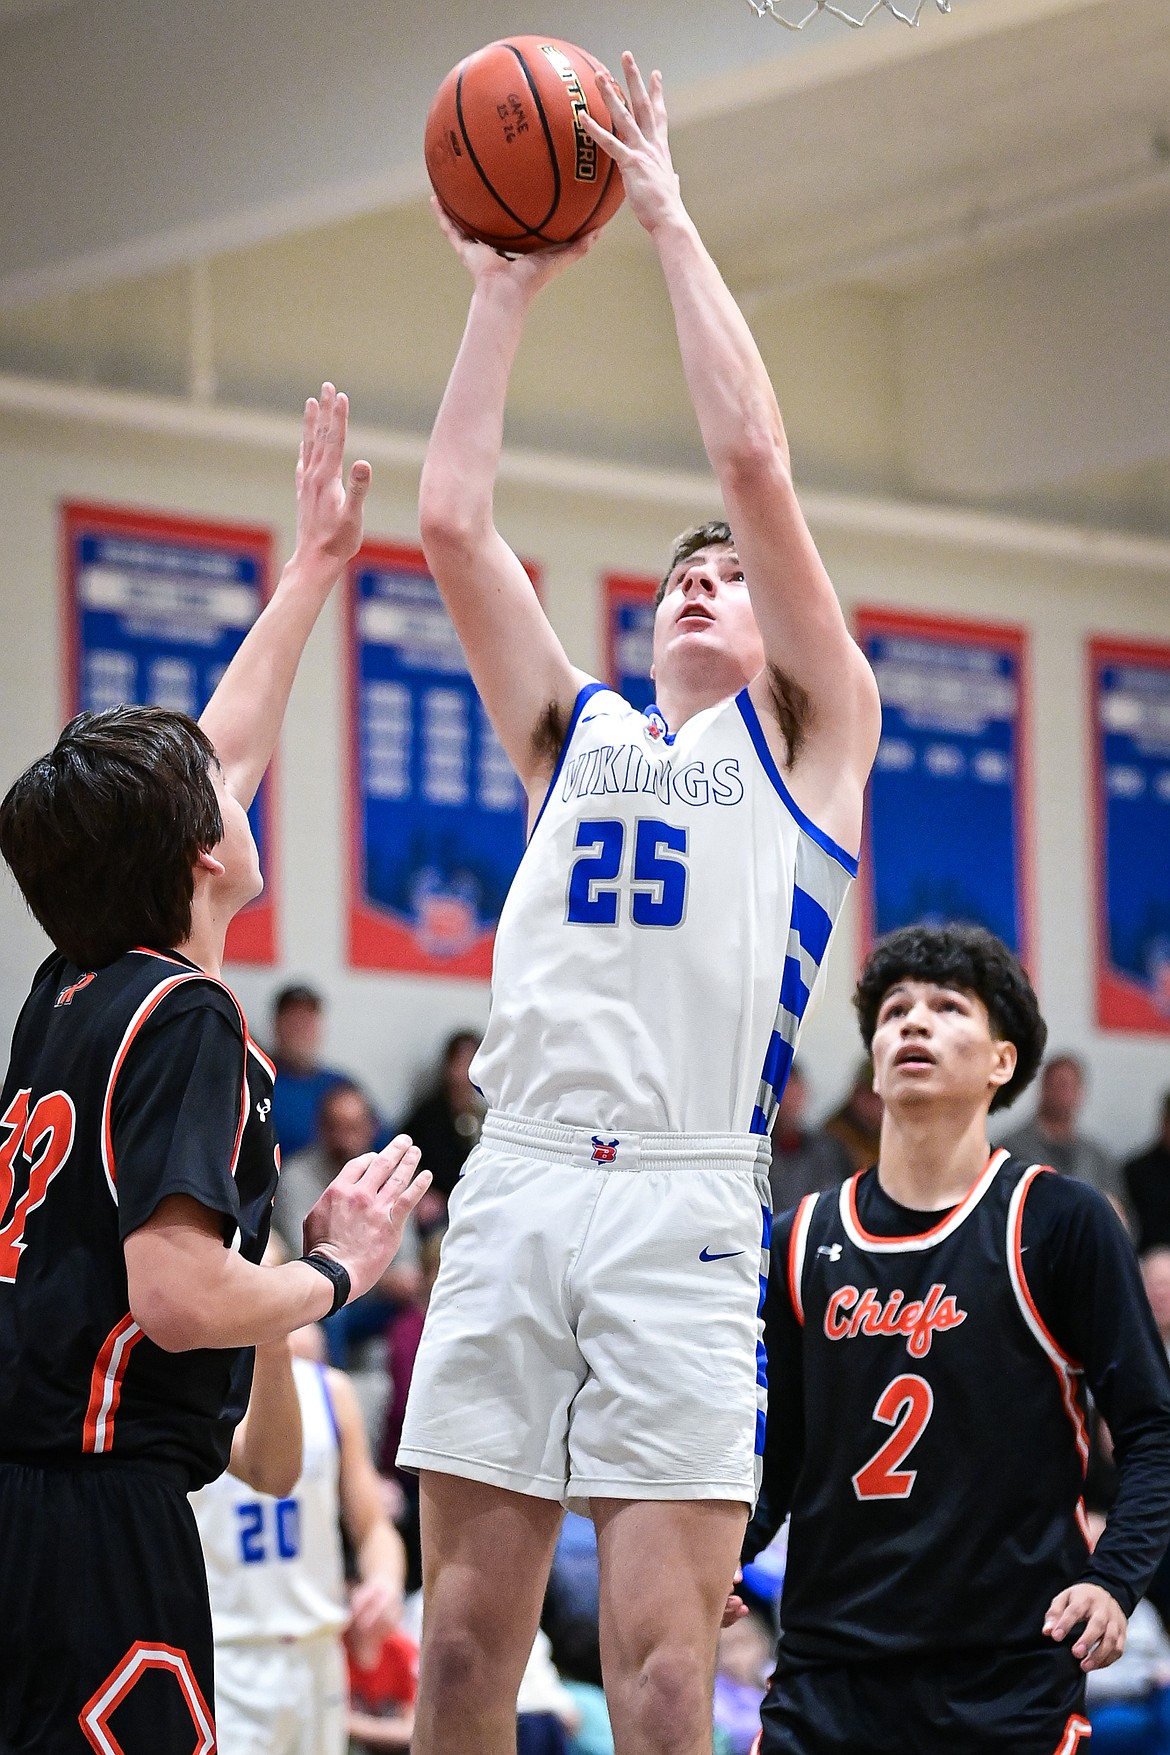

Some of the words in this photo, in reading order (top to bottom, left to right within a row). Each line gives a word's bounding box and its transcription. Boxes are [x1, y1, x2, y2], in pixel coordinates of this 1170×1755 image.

[506, 93, 529, 135] GAME
[537, 45, 590, 129] EITE
[577, 130, 596, 179] PRO
[561, 744, 745, 807] VIKINGS
[563, 815, 691, 931] 25
[823, 1283, 968, 1359] Chiefs
[852, 1373, 935, 1501] 2
[234, 1497, 300, 1563] 20
